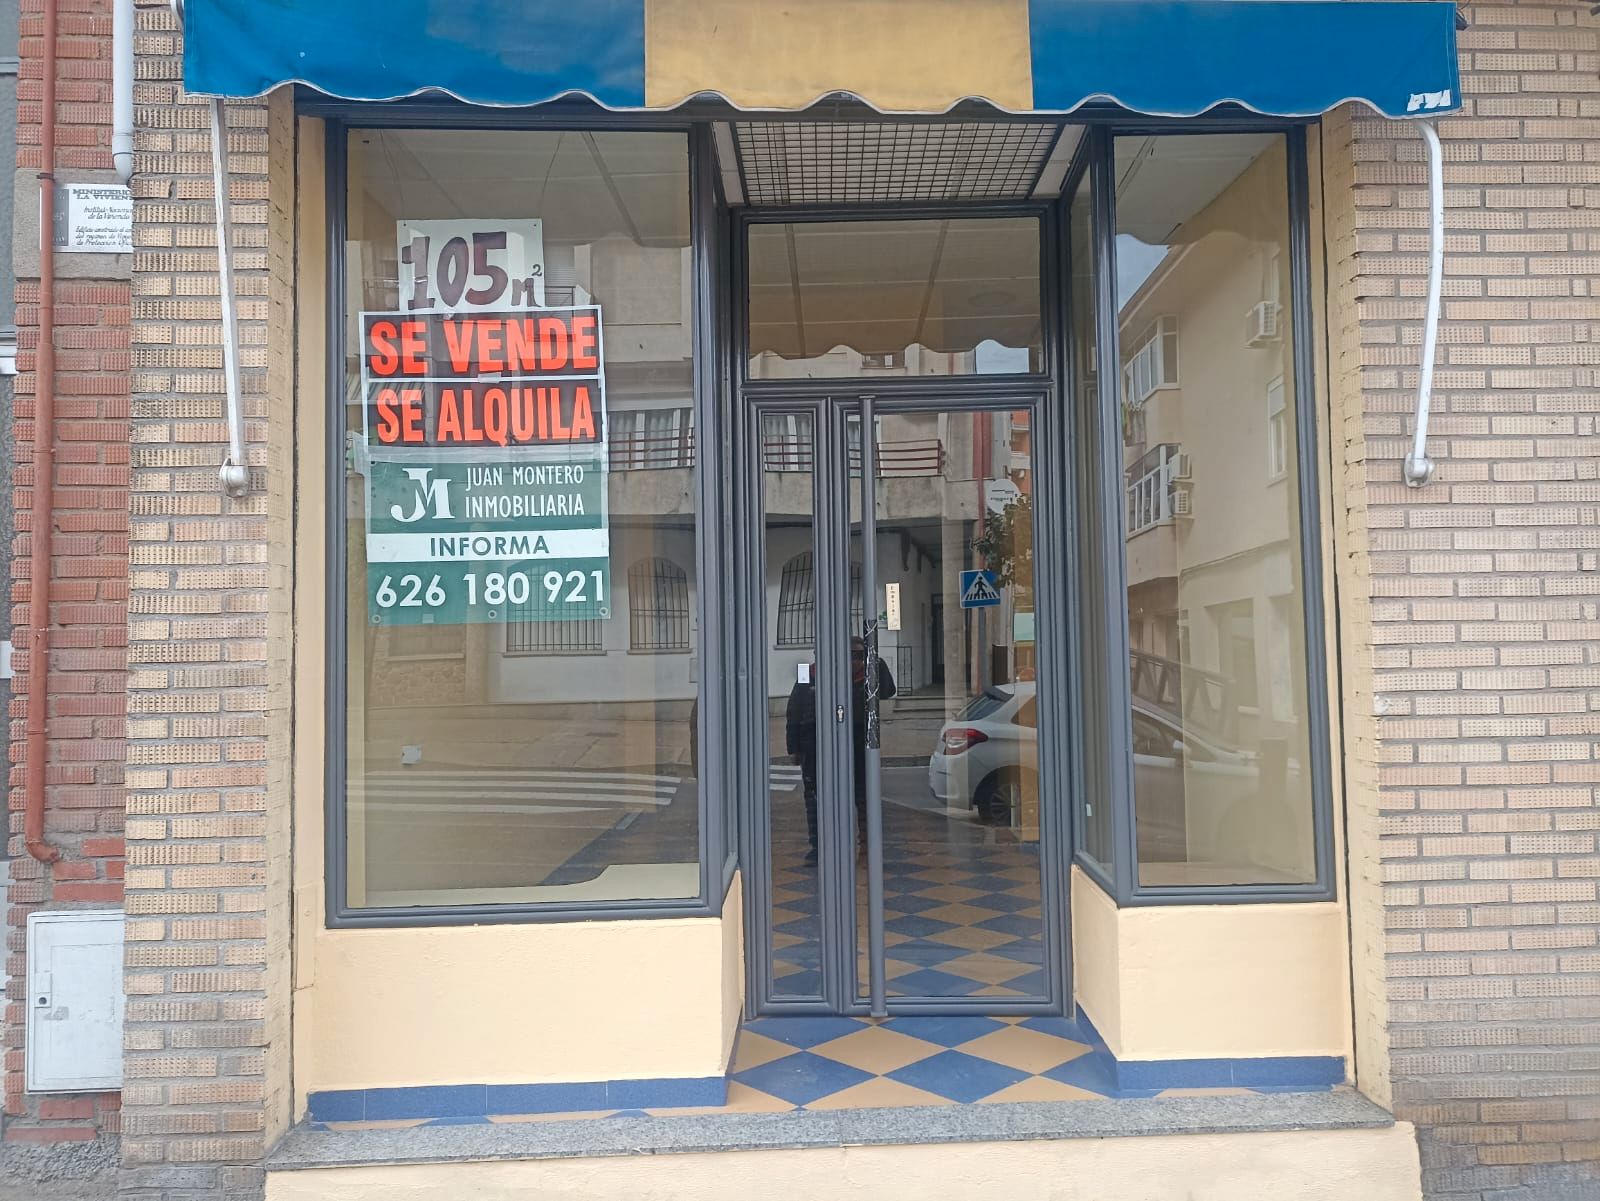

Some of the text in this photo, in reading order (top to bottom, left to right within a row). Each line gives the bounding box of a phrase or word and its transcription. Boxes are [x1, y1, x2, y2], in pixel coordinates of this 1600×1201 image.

[370, 316, 598, 376] SE VENDE
[377, 386, 596, 447] SE ALQUILA
[465, 464, 584, 492] JUAN MONTERO
[465, 493, 585, 519] INMOBILIARIA
[430, 534, 550, 557] INFORMA
[375, 570, 605, 608] 626 180 921
